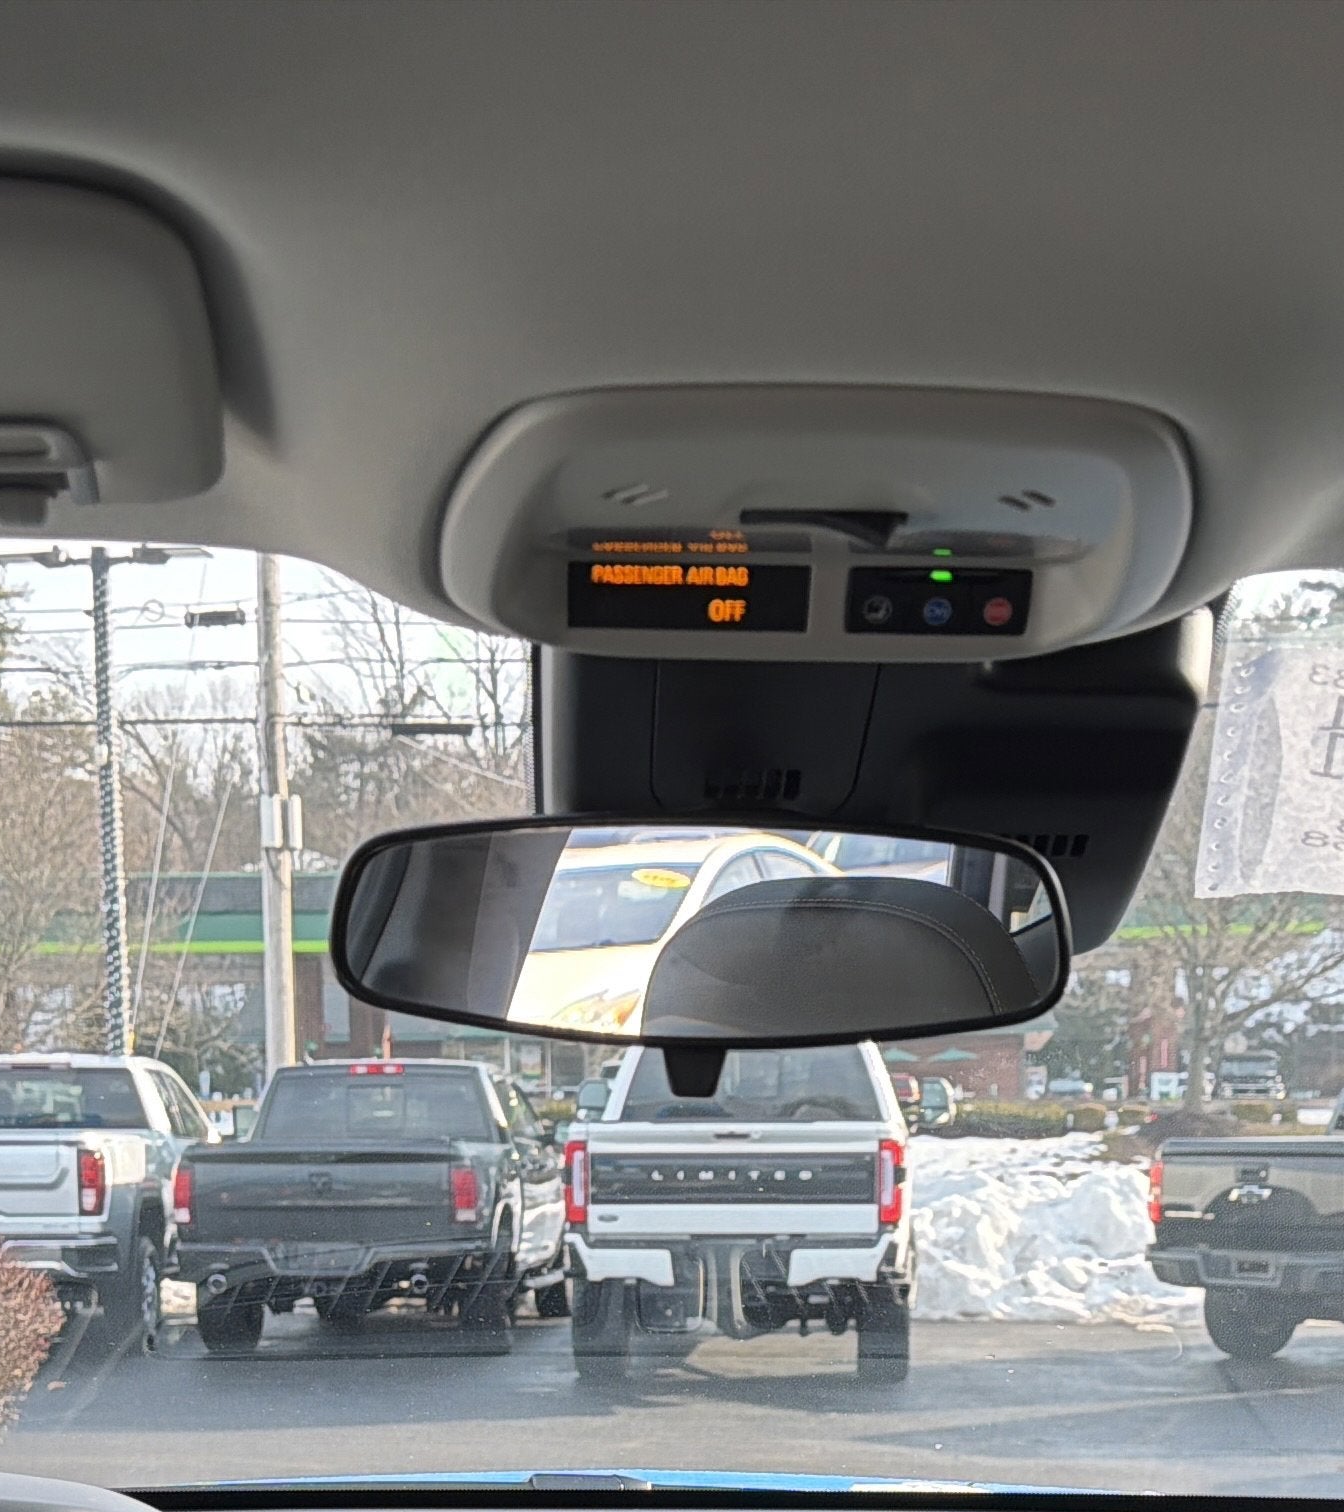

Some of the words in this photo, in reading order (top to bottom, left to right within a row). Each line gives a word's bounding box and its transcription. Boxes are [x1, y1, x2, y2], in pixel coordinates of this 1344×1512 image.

[591, 565, 684, 586] PASSENGER
[686, 566, 714, 586] AIR
[715, 566, 749, 587] BAG
[708, 598, 746, 623] OFF
